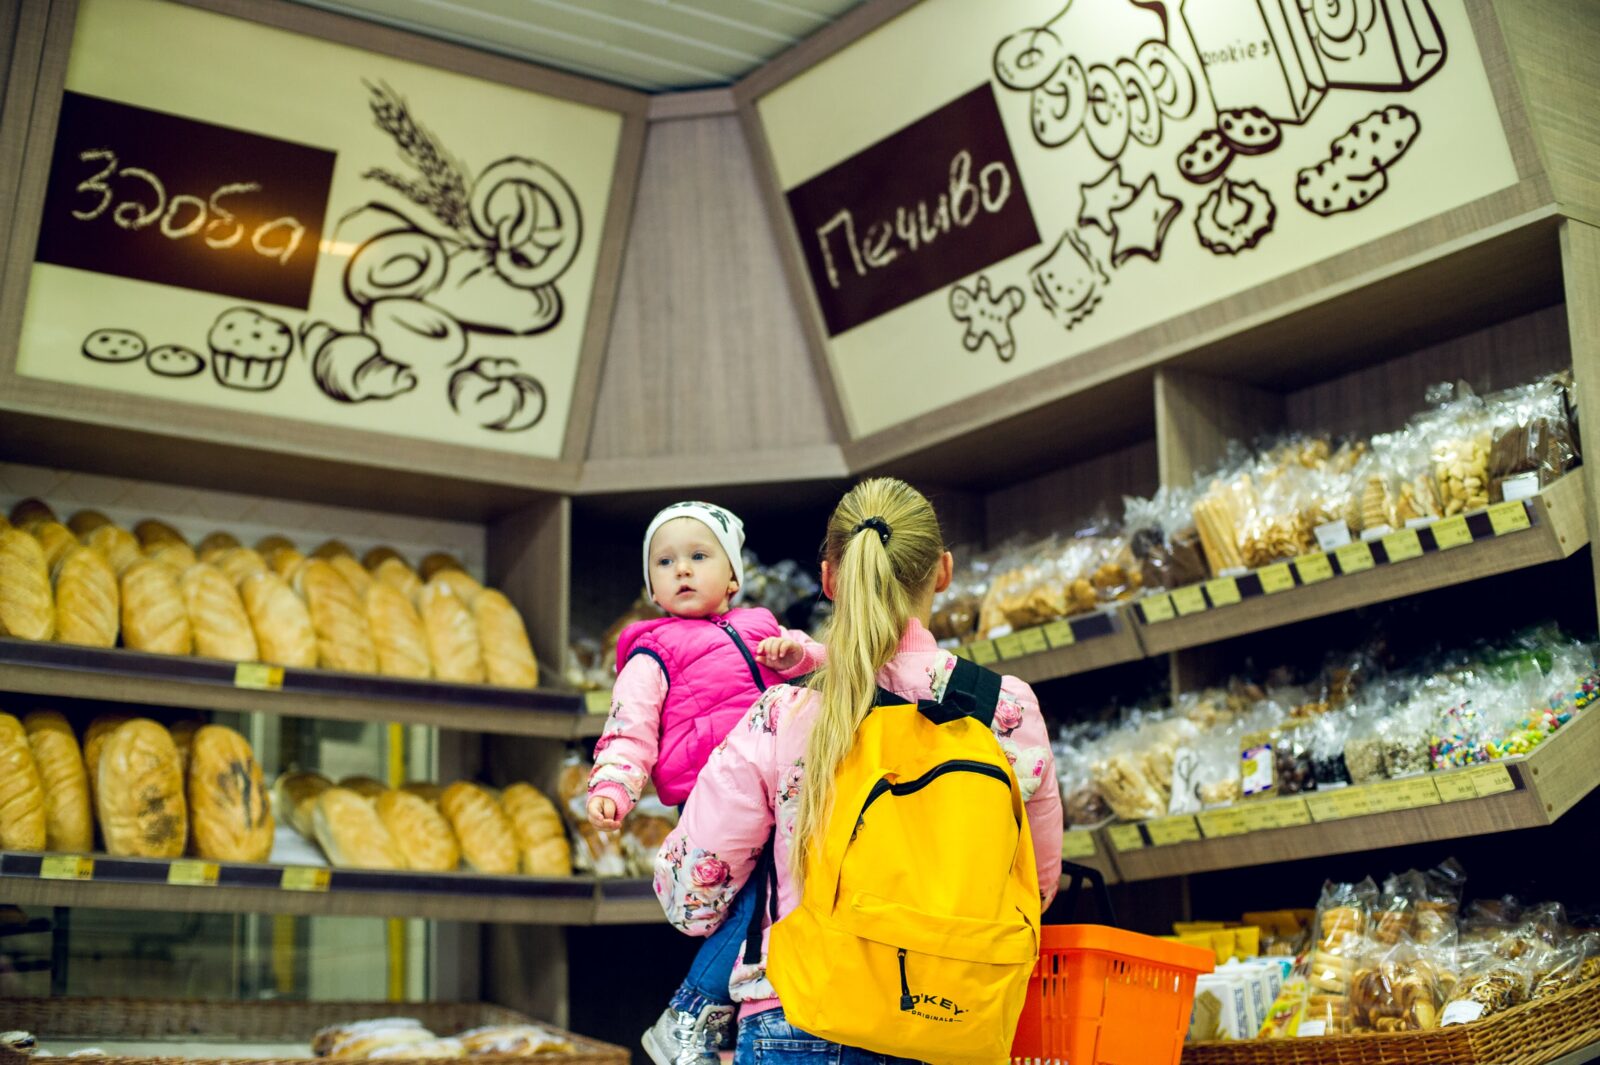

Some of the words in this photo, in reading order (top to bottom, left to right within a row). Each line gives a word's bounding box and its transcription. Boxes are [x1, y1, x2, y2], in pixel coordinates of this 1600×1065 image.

[71, 149, 306, 264] Здоба
[816, 149, 1011, 289] Печиво
[911, 1009, 954, 1023] ORIGINALS
